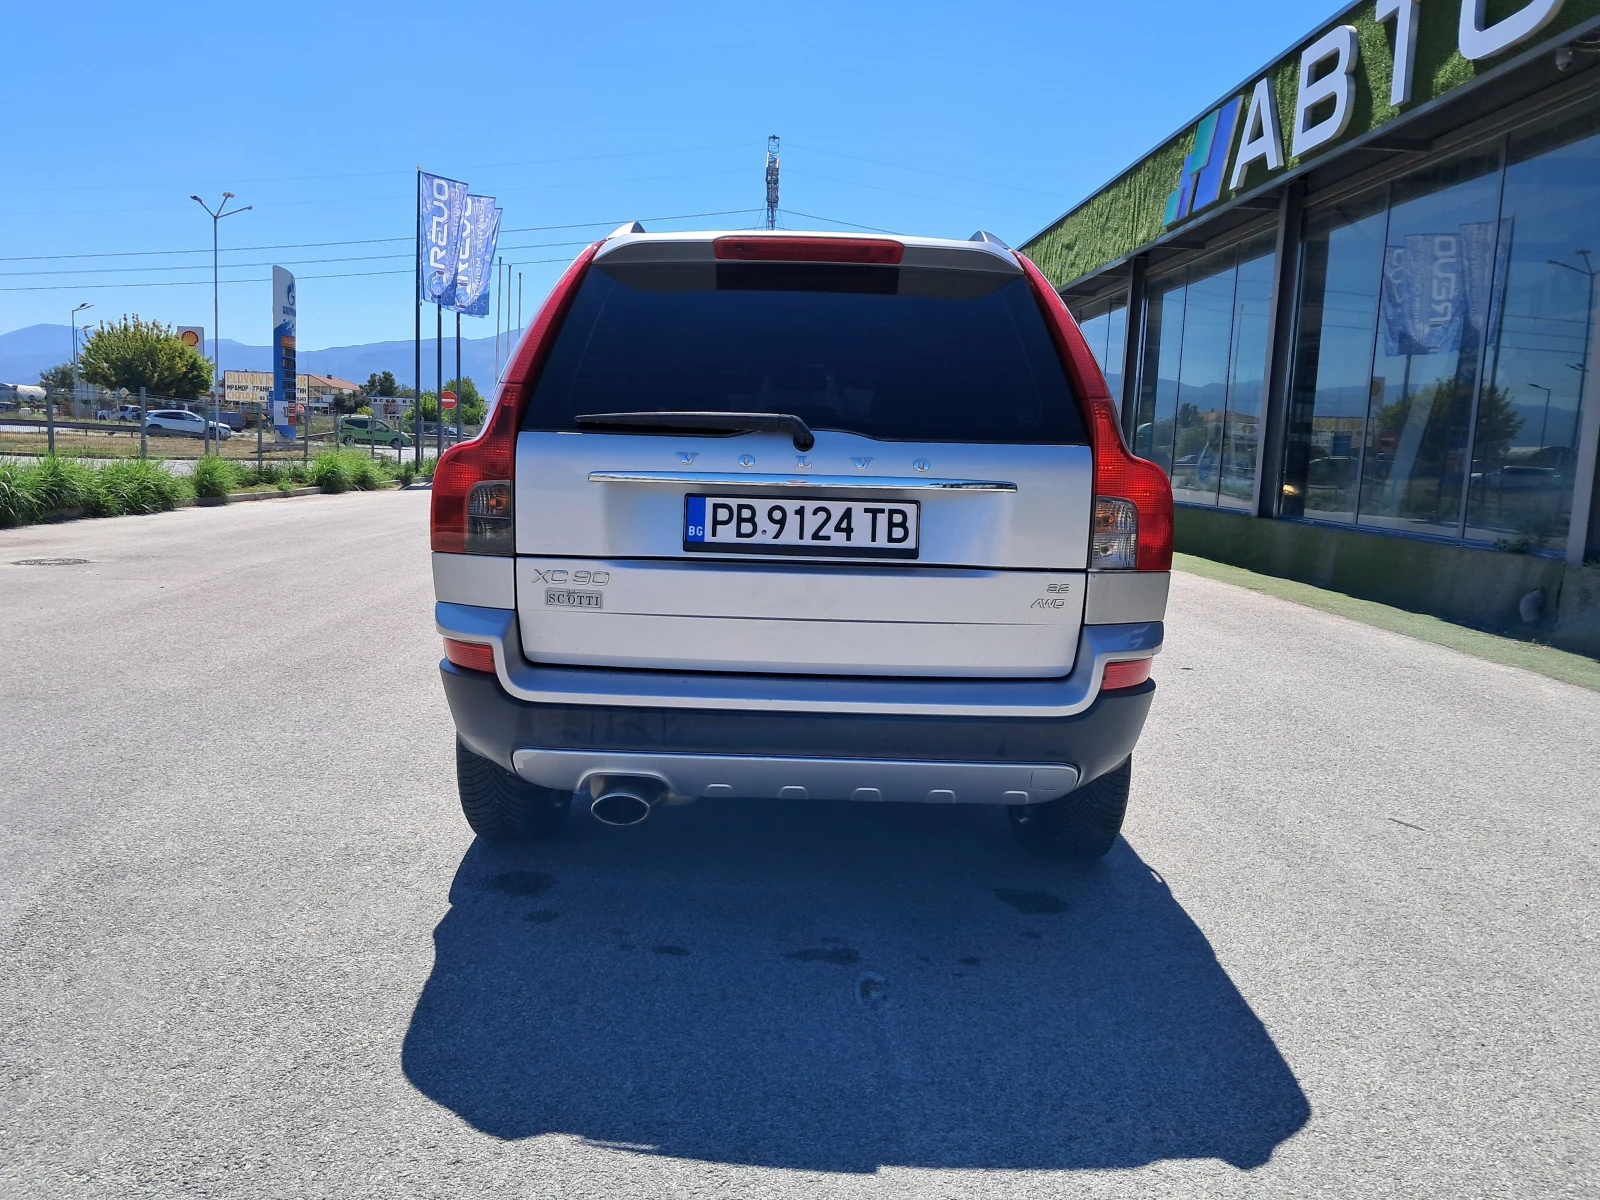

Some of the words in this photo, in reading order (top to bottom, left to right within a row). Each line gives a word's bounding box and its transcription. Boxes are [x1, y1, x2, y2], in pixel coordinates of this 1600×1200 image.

[429, 178, 449, 269] REVO
[226, 373, 263, 384] PLOVDIV
[676, 451, 931, 472] VOLVO
[688, 525, 704, 537] BG
[531, 568, 568, 584] XC
[572, 570, 610, 586] 90
[548, 593, 599, 606] SCOTTI
[1030, 598, 1066, 609] AWD
